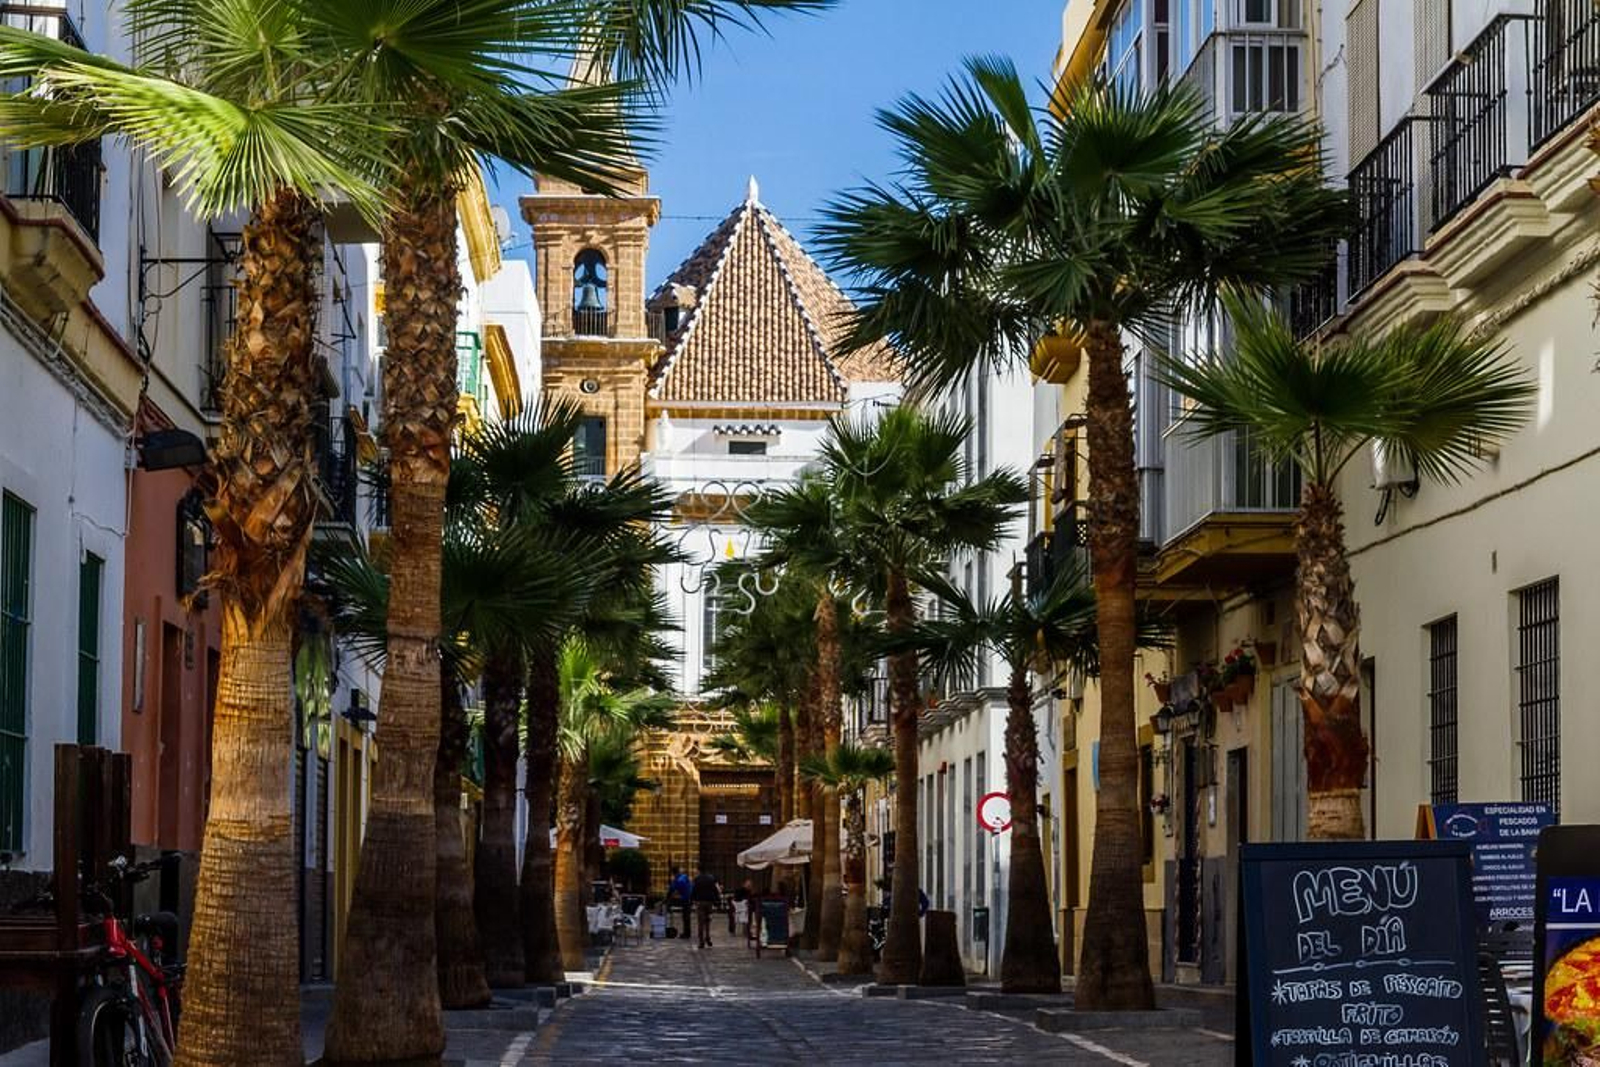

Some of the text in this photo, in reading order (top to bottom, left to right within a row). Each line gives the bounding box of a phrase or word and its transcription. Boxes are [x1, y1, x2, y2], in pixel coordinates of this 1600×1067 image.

[1484, 805, 1546, 815] ESPECIALIDAD EN
[1499, 817, 1538, 826] PESCADOS
[1499, 829, 1509, 837] DE
[1510, 829, 1520, 837] LA
[1293, 861, 1418, 923] MENÚ
[1490, 906, 1534, 918] ARROCES
[1298, 914, 1407, 964] DEL DÍA
[1350, 980, 1372, 997] DE
[1361, 1028, 1382, 1045] DE
